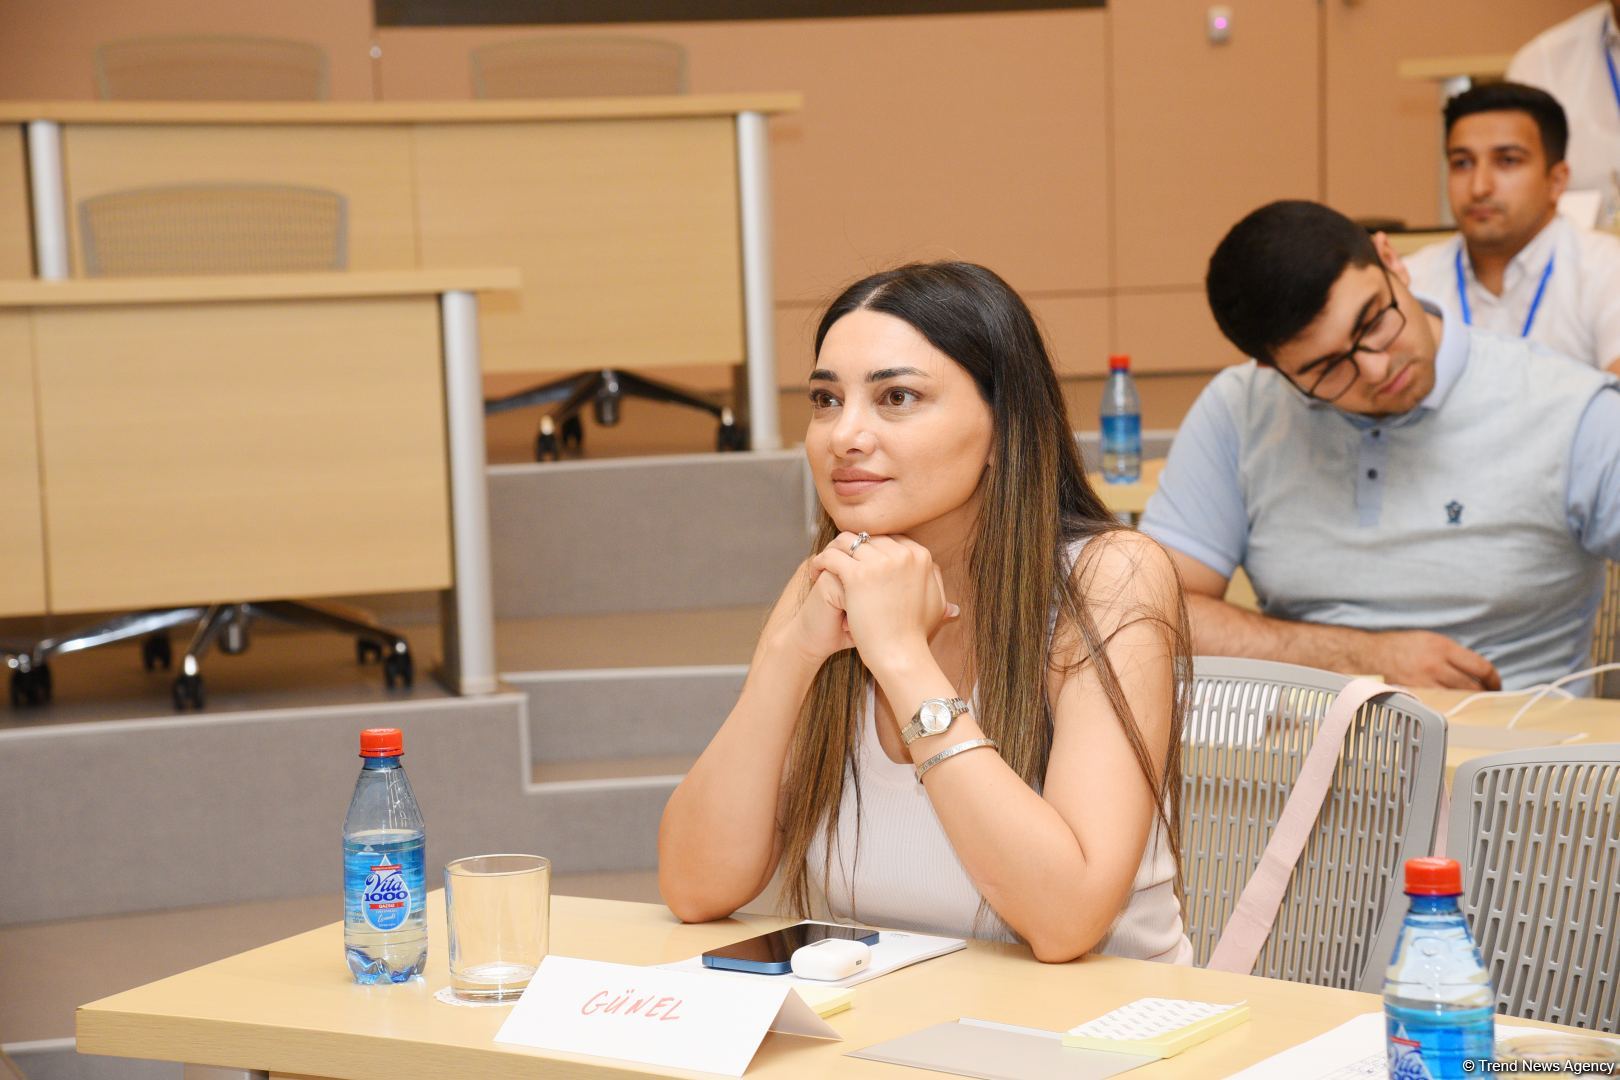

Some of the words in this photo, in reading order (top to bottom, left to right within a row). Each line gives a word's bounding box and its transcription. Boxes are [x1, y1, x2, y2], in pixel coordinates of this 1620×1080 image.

[365, 871, 402, 893] Vita
[365, 891, 408, 902] 1000
[581, 989, 683, 1021] GÜNEL
